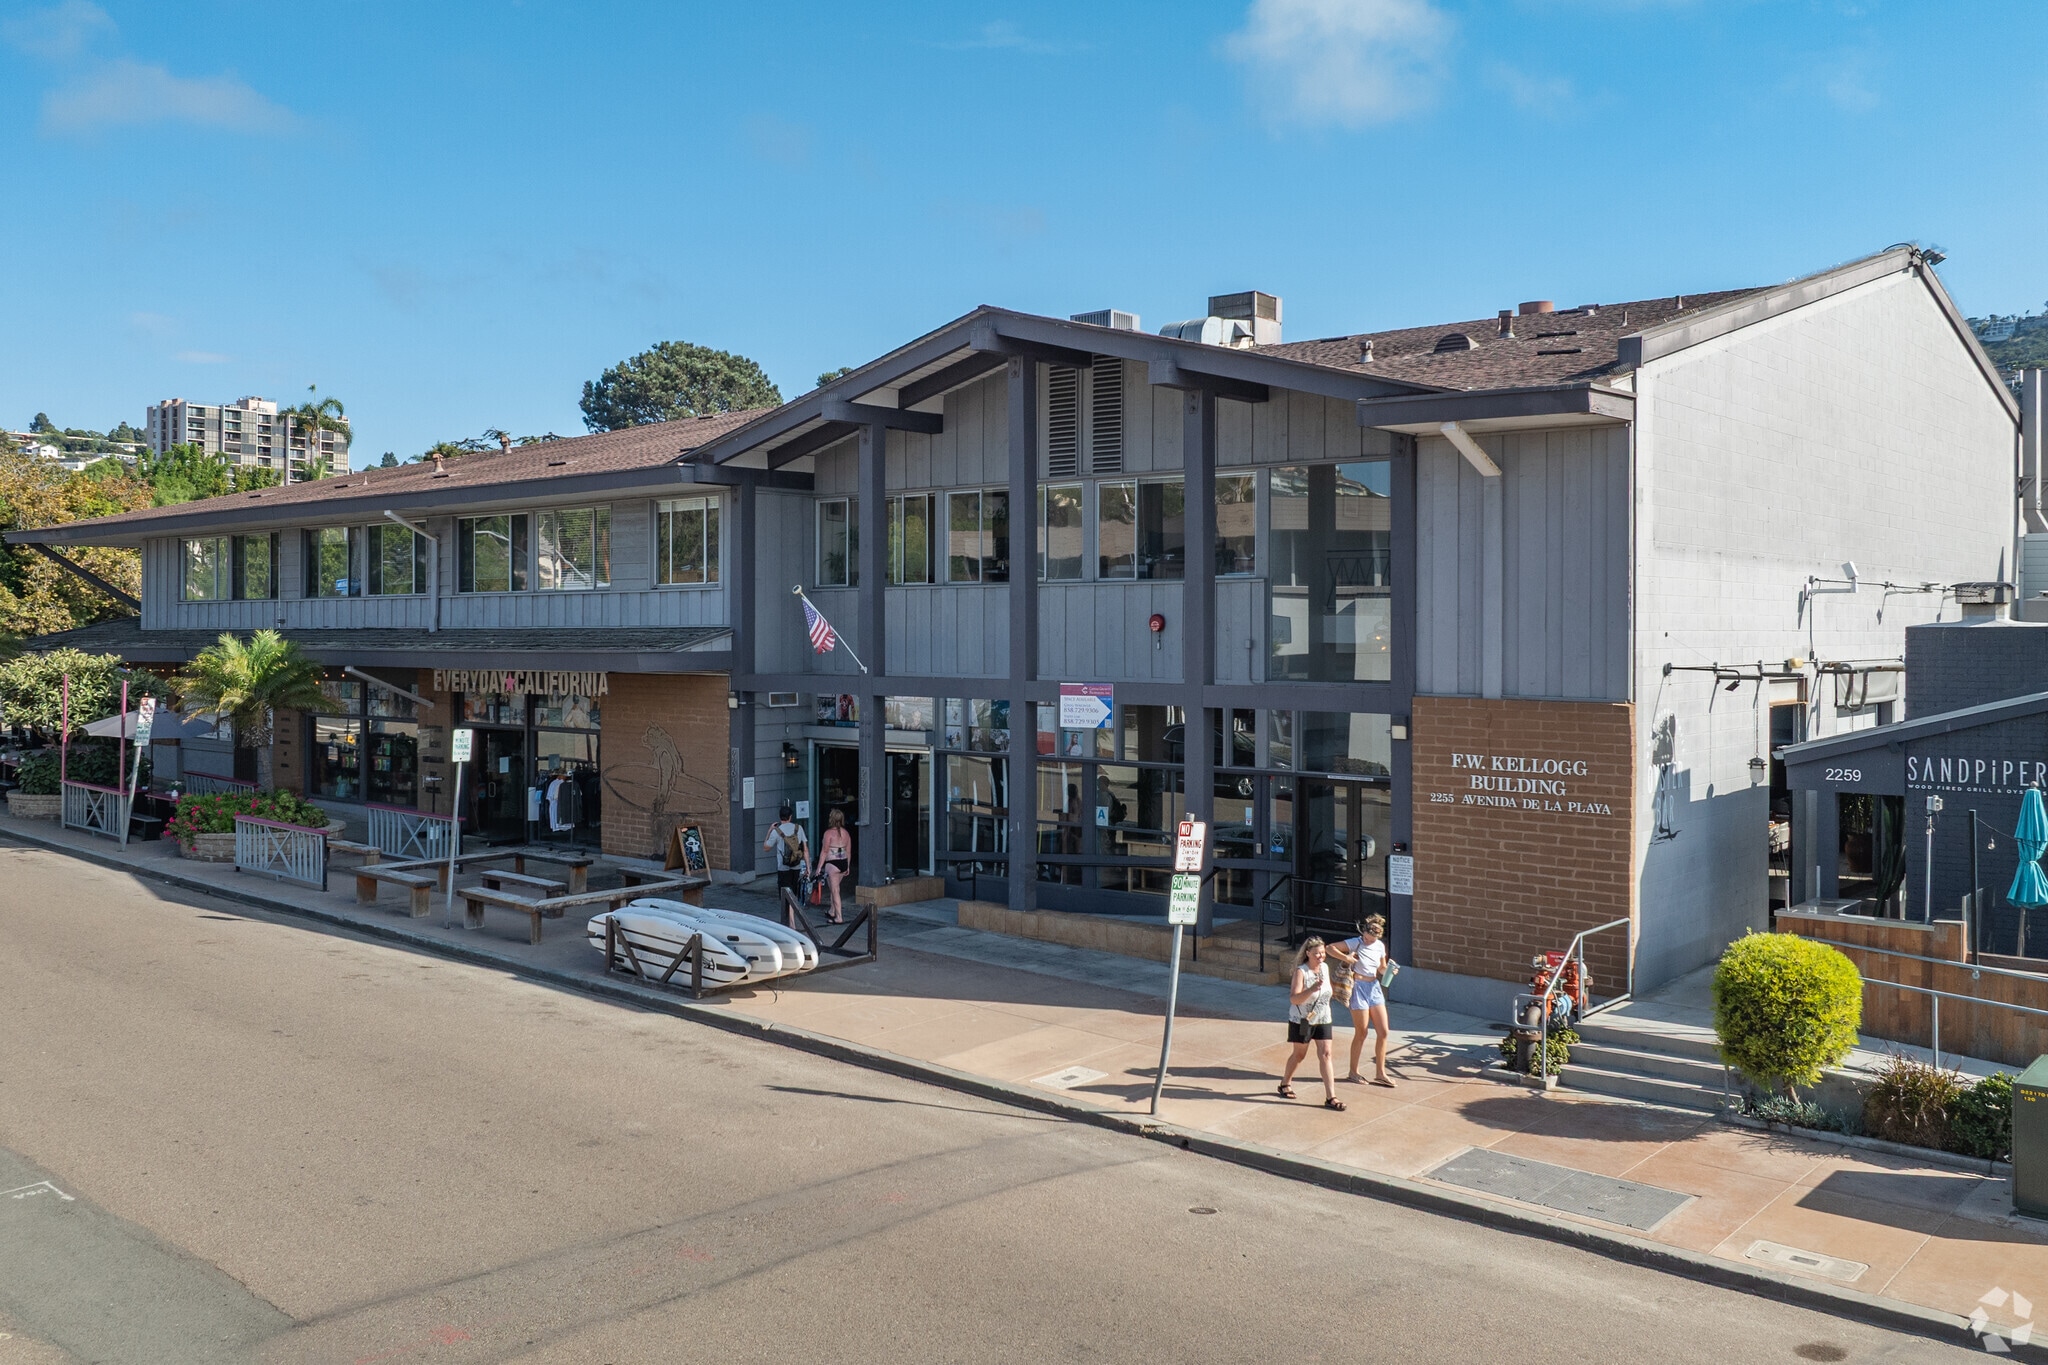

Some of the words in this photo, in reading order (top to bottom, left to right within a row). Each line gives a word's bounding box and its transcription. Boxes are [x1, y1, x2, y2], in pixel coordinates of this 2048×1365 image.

[433, 669, 506, 693] EVERYDAY
[514, 671, 608, 697] CALIFORNIA
[1451, 753, 1486, 770] F.W.
[1491, 755, 1588, 777] KELLOGG
[1647, 761, 1683, 794] OYSTER
[1825, 768, 1862, 782] 2259
[1470, 774, 1567, 797] BUILDING
[1430, 792, 1454, 804] 2255
[1461, 794, 1517, 809] AVENIDA
[1522, 798, 1540, 811] DE
[1544, 800, 1562, 813] LA
[1567, 801, 1612, 816] PLAYA
[1656, 794, 1675, 827] BAR
[1097, 809, 1106, 819] A
[1181, 824, 1191, 835] NO
[1180, 839, 1202, 849] PARKING
[1173, 876, 1182, 889] 90
[1183, 880, 1198, 889] MINUTE
[1173, 892, 1197, 902] PARKING
